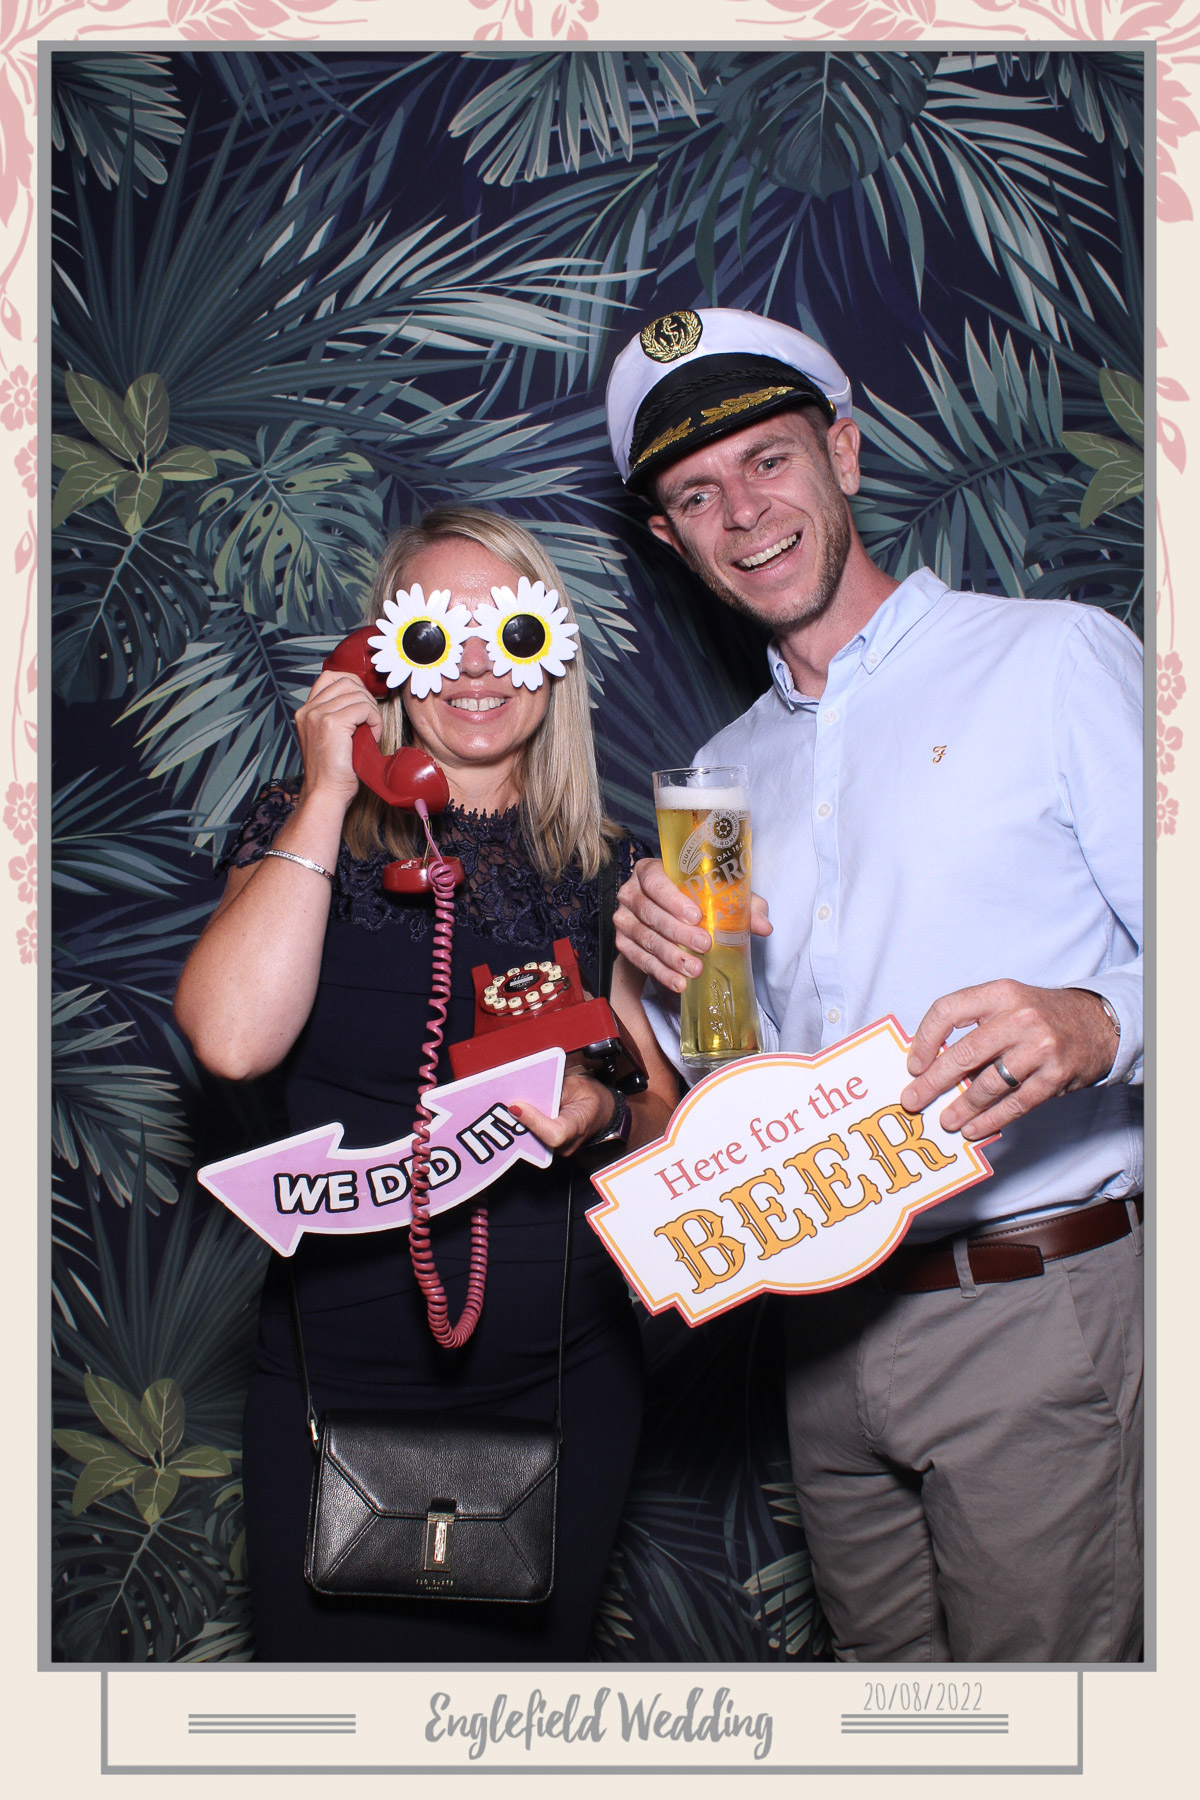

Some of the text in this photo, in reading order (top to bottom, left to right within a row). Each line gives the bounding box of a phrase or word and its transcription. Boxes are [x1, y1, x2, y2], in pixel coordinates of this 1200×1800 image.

[274, 1171, 358, 1214] WE
[653, 1103, 957, 1294] BEER
[654, 1075, 869, 1200] Here for the
